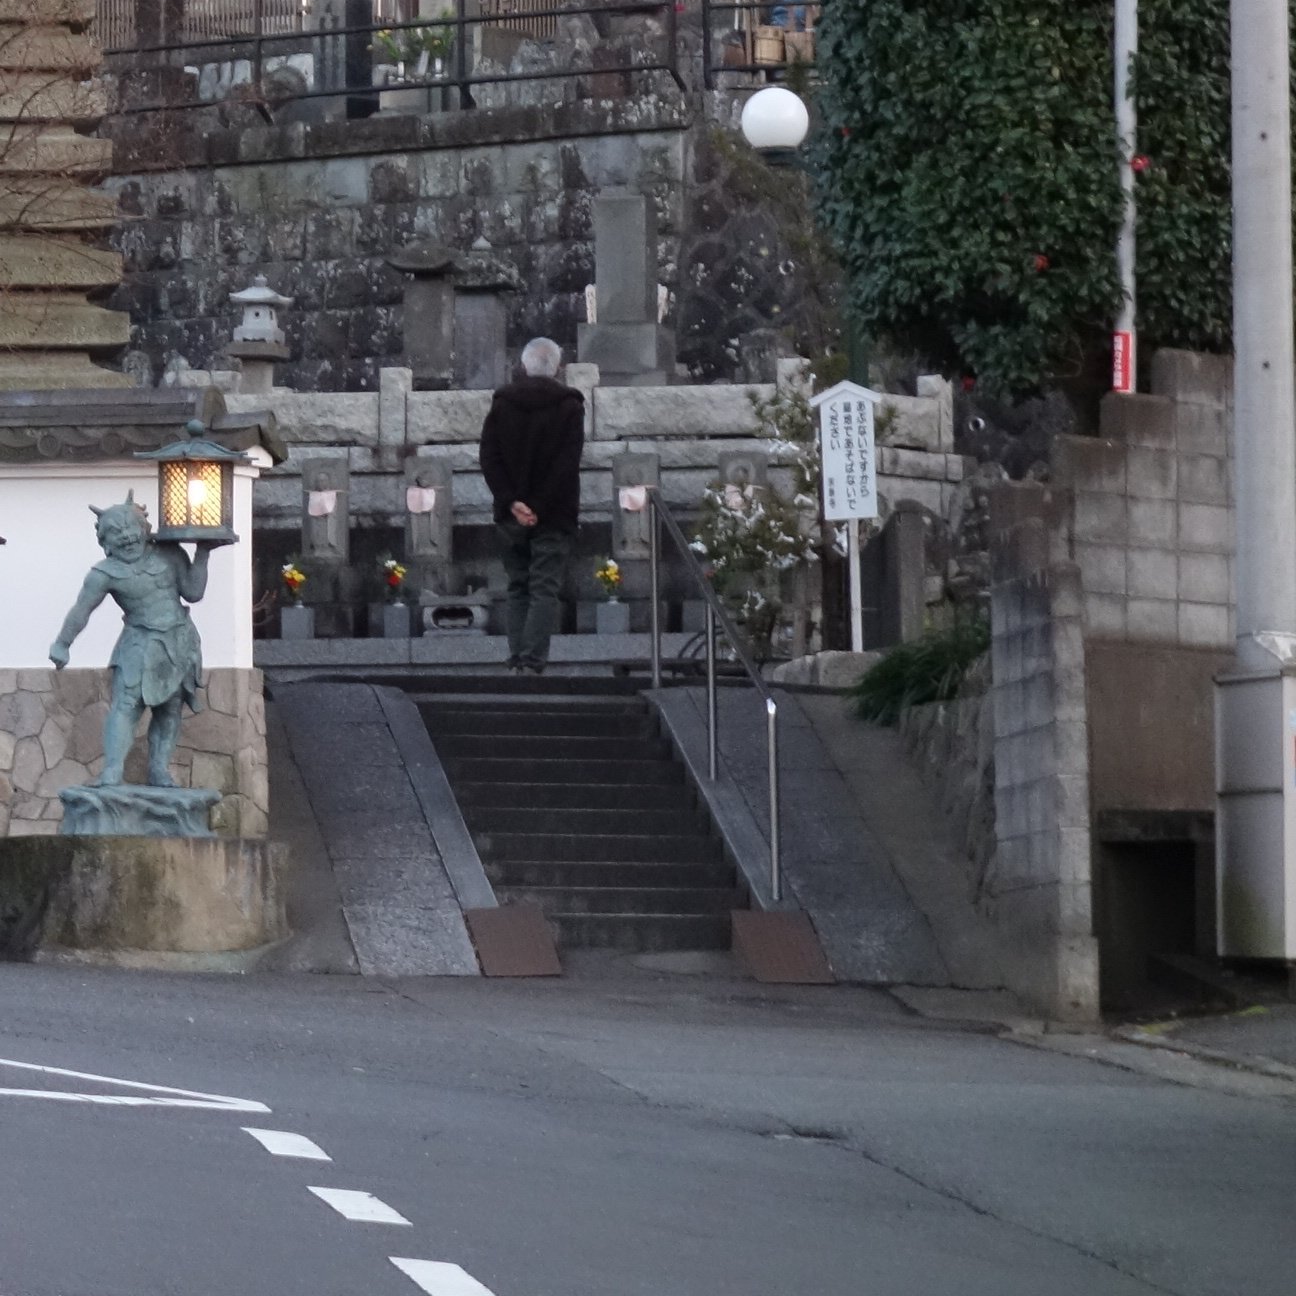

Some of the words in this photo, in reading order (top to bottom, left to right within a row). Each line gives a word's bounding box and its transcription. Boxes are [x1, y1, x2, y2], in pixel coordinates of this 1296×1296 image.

[830, 401, 841, 451] ください
[856, 400, 870, 498] あぶないですから
